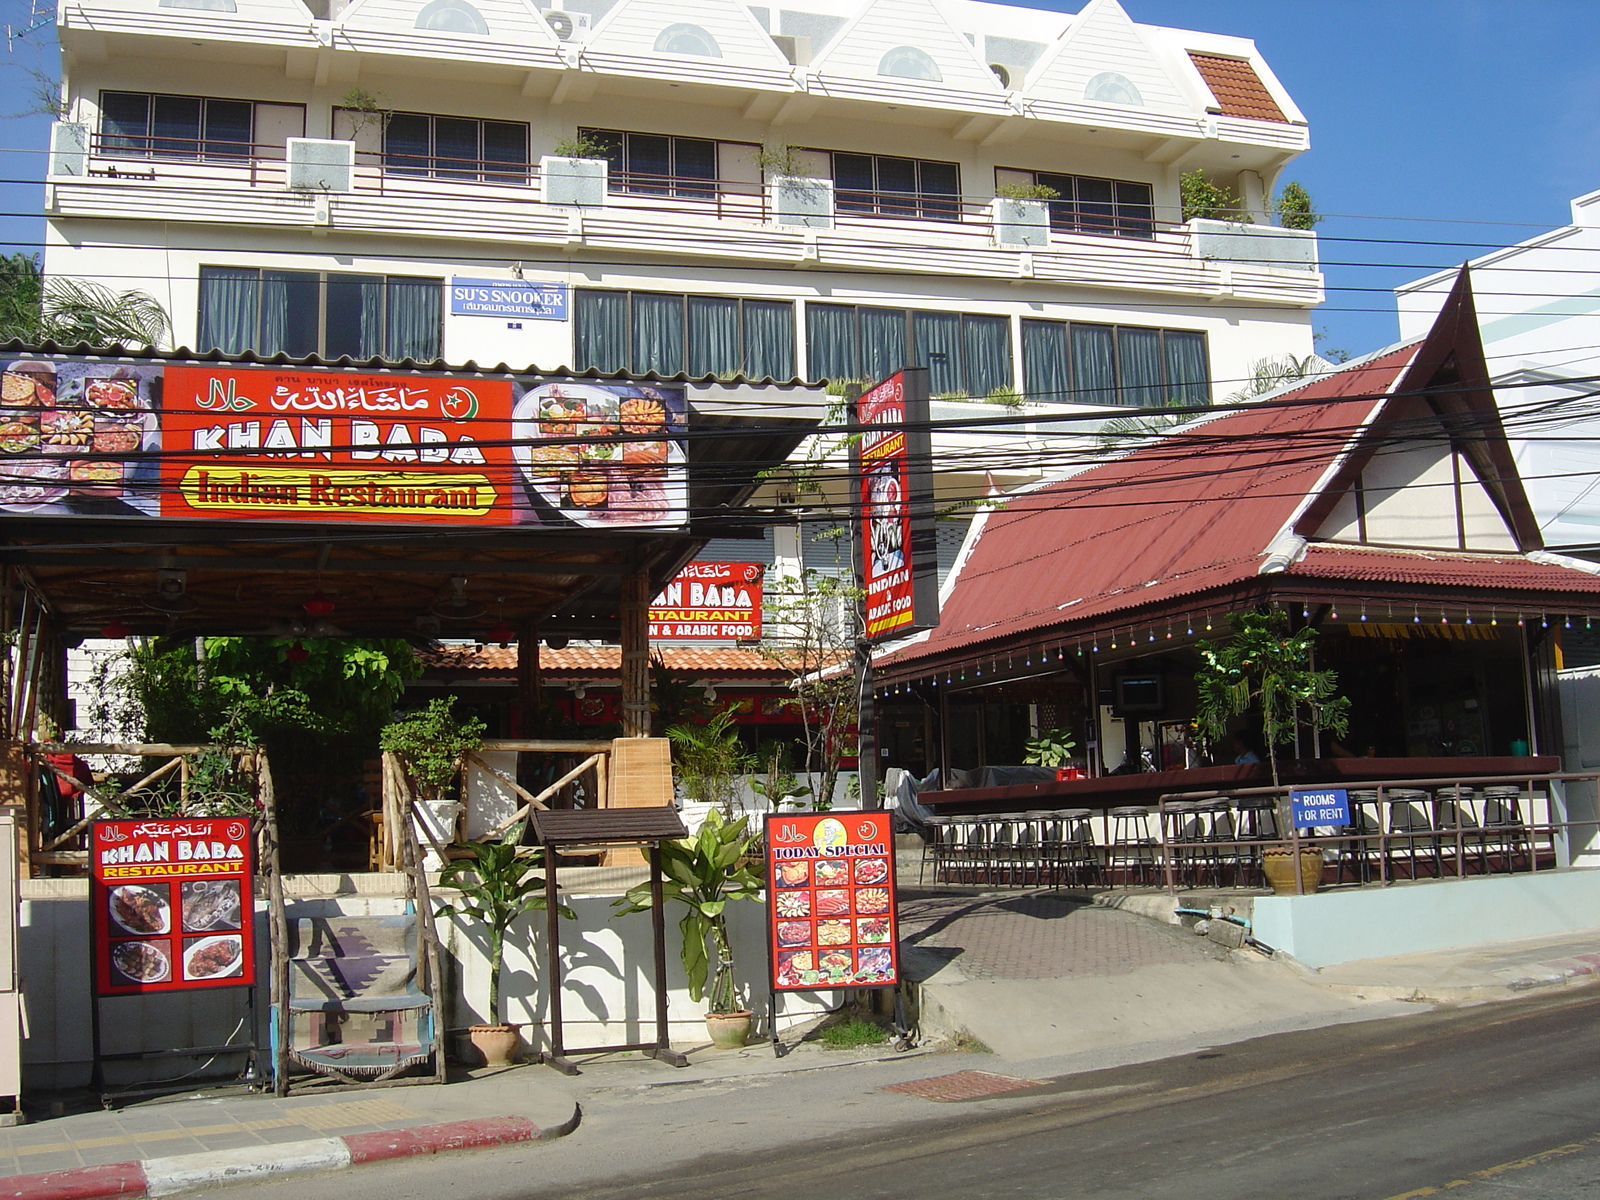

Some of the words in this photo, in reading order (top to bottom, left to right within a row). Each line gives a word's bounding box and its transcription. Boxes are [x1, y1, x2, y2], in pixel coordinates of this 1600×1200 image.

[455, 288, 488, 301] SU'S
[492, 290, 563, 306] SNOOKER
[193, 416, 332, 461] KHAN
[351, 420, 487, 464] BABA
[196, 470, 298, 505] Indian
[309, 474, 478, 508] Restaurant
[868, 569, 909, 595] INDIAN
[651, 582, 682, 607] AN
[690, 582, 752, 607] BABA
[886, 590, 892, 601] &
[648, 611, 753, 620] STAURANT
[868, 602, 891, 620] ARABIC
[893, 595, 911, 612] FOOD
[662, 625, 671, 635] &
[676, 625, 718, 635] ARABIC
[722, 625, 753, 636] FOOD
[1303, 794, 1336, 806] ROOMS
[1298, 809, 1317, 821] FOR
[1320, 808, 1343, 820] RENT
[101, 841, 169, 864] KHAN
[178, 840, 244, 860] BABA
[773, 846, 821, 859] TODAY
[825, 843, 888, 857] SPECIAL
[103, 862, 243, 877] RESTAURANT
